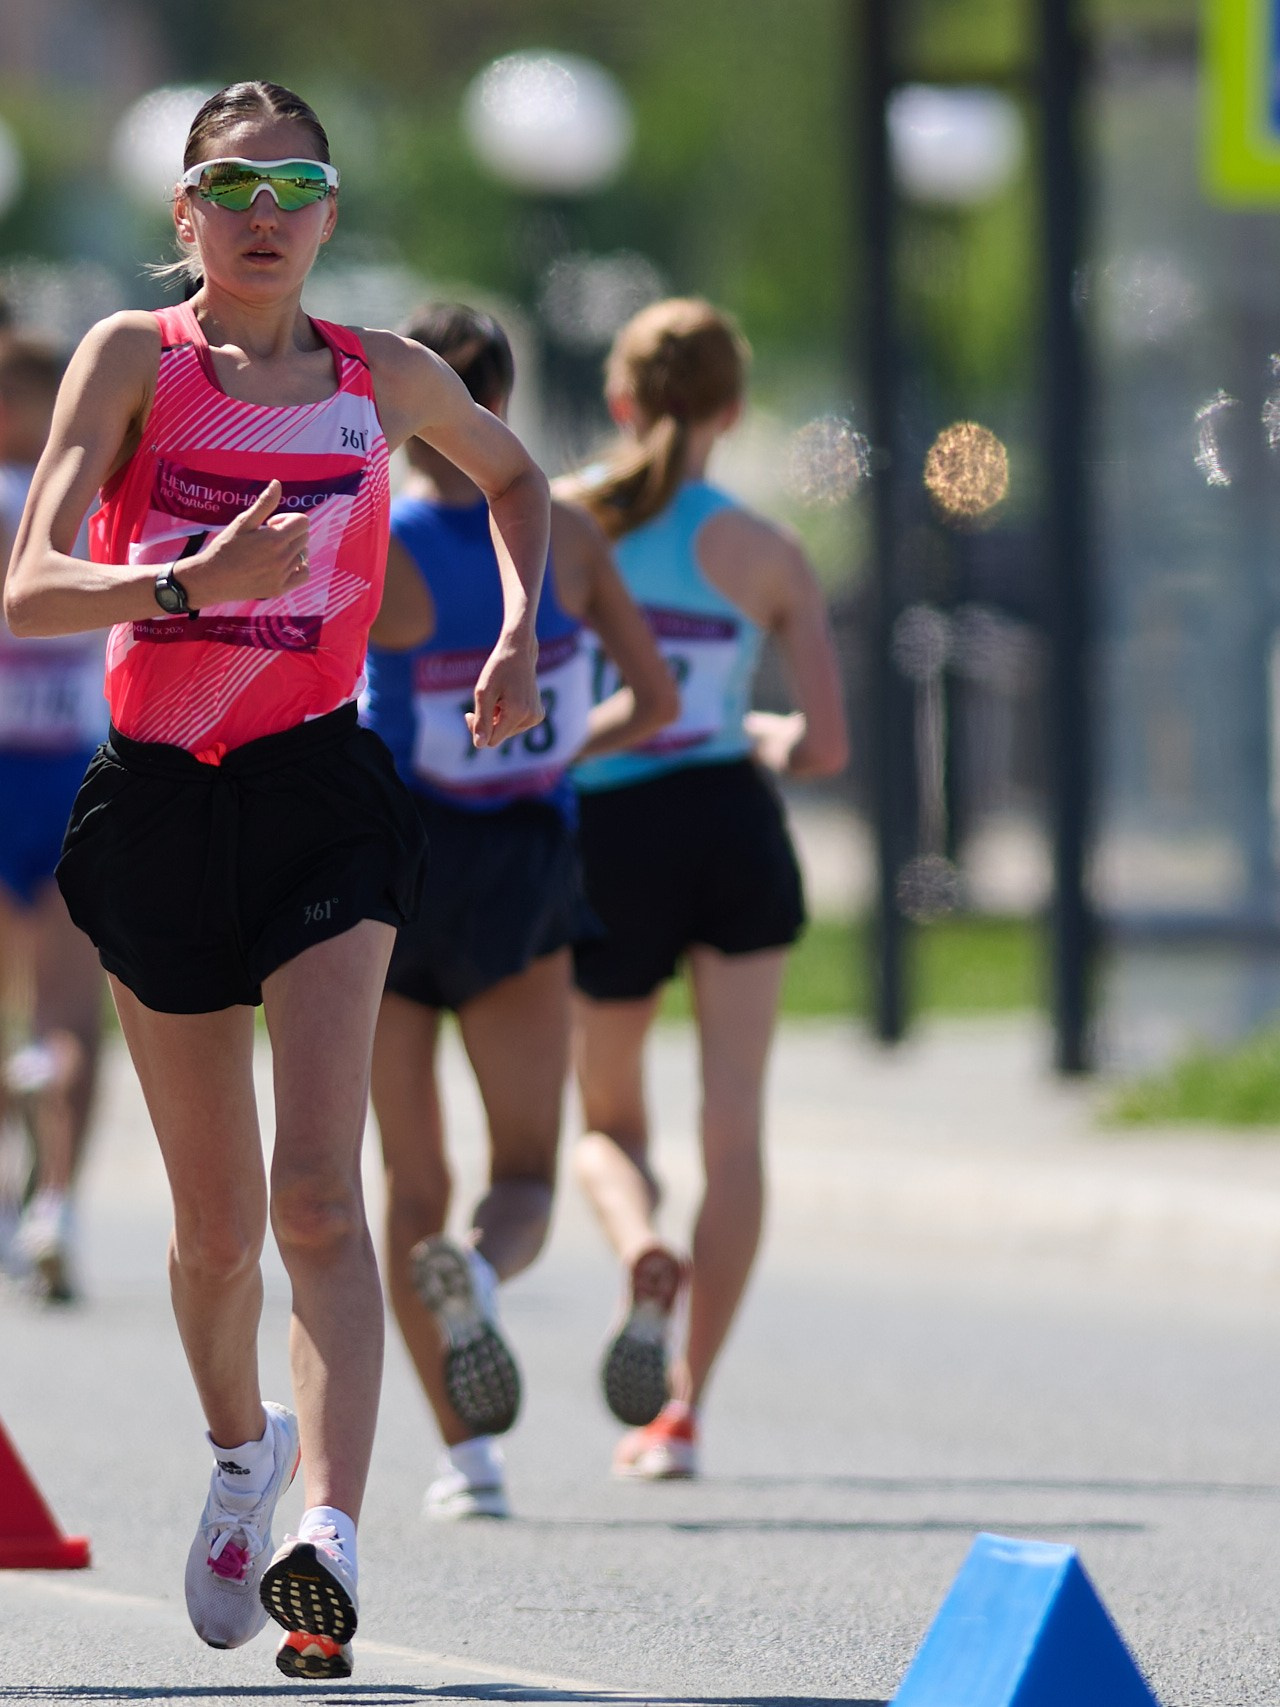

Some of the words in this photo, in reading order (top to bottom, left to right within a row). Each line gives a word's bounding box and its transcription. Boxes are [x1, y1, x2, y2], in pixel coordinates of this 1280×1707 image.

[160, 486, 174, 498] по
[162, 472, 260, 507] ЧЕМПИОНА
[279, 493, 330, 508] РОСС
[133, 624, 163, 635] КИНСК
